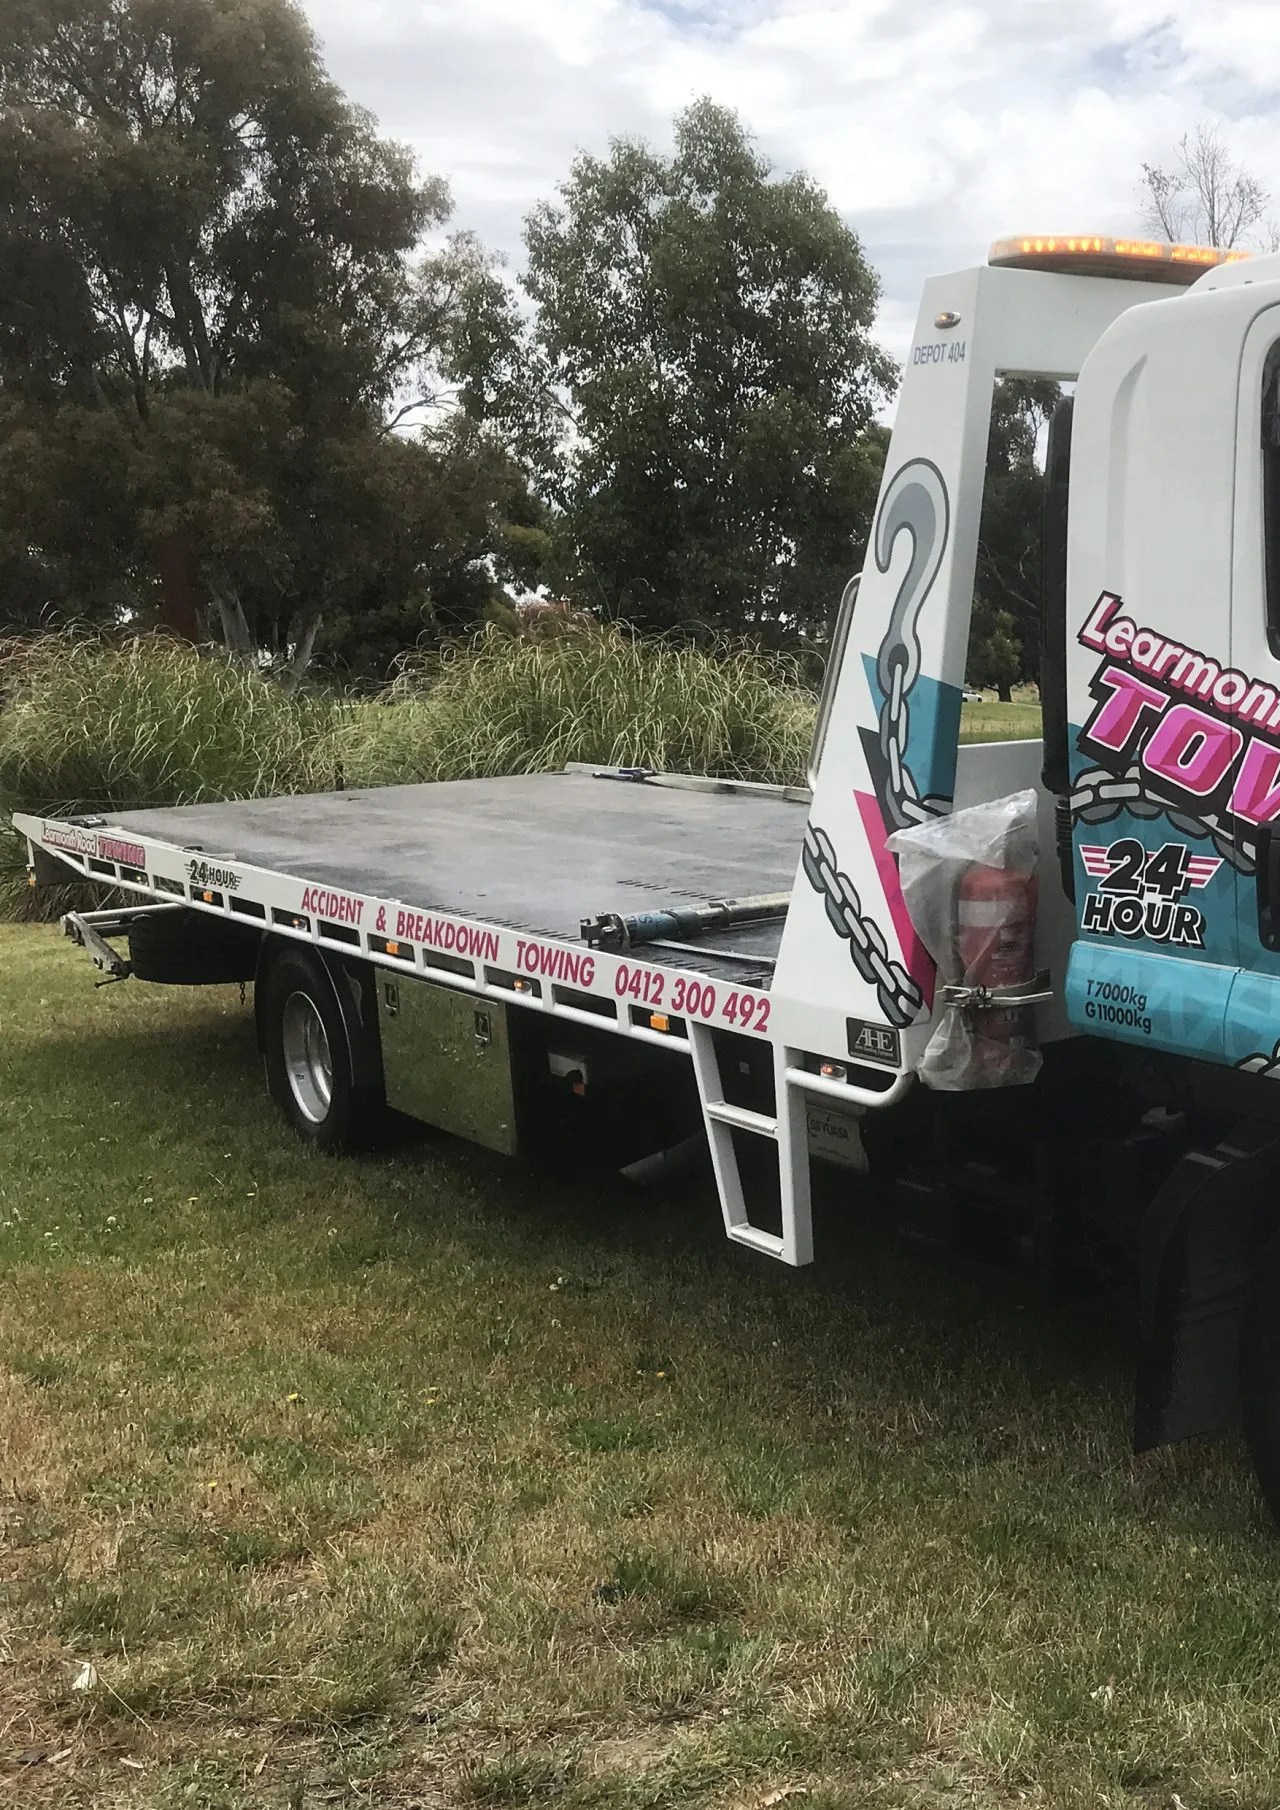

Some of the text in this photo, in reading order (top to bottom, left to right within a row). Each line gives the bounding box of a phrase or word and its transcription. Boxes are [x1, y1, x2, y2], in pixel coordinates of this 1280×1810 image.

[914, 341, 966, 365] DEPOT 404
[42, 821, 146, 870] Learmonth Road TOWING
[1097, 837, 1191, 901] 24
[190, 859, 237, 890] 24 HOUR
[1081, 893, 1206, 950] HOUR
[301, 887, 771, 1033] ACCIDENT & BREAKDOWN TOWING 0412 300 492
[856, 1028, 893, 1051] AHE
